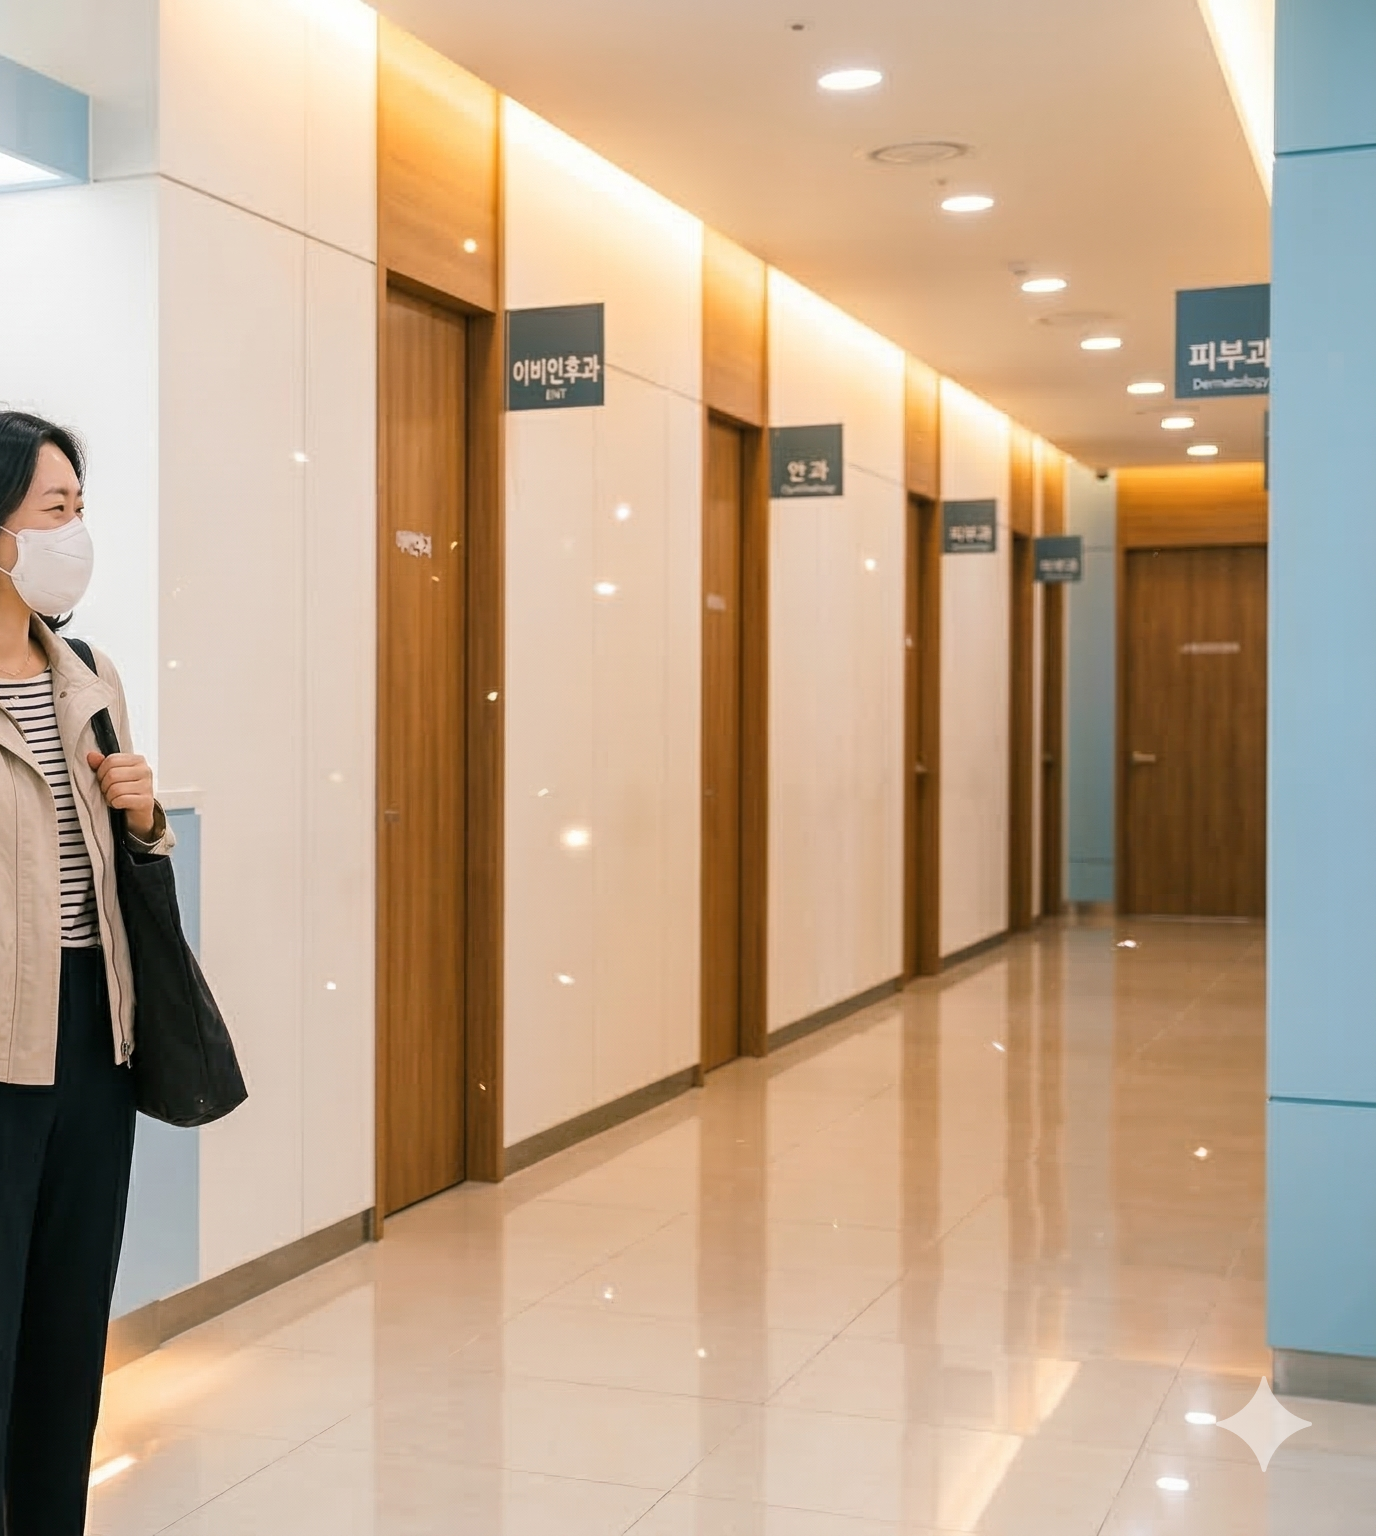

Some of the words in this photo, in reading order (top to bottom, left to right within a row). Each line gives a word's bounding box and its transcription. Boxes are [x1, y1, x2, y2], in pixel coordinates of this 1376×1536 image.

[513, 354, 600, 387] 이비인후과
[1188, 337, 1270, 371] 피부과
[546, 388, 567, 400] ENT
